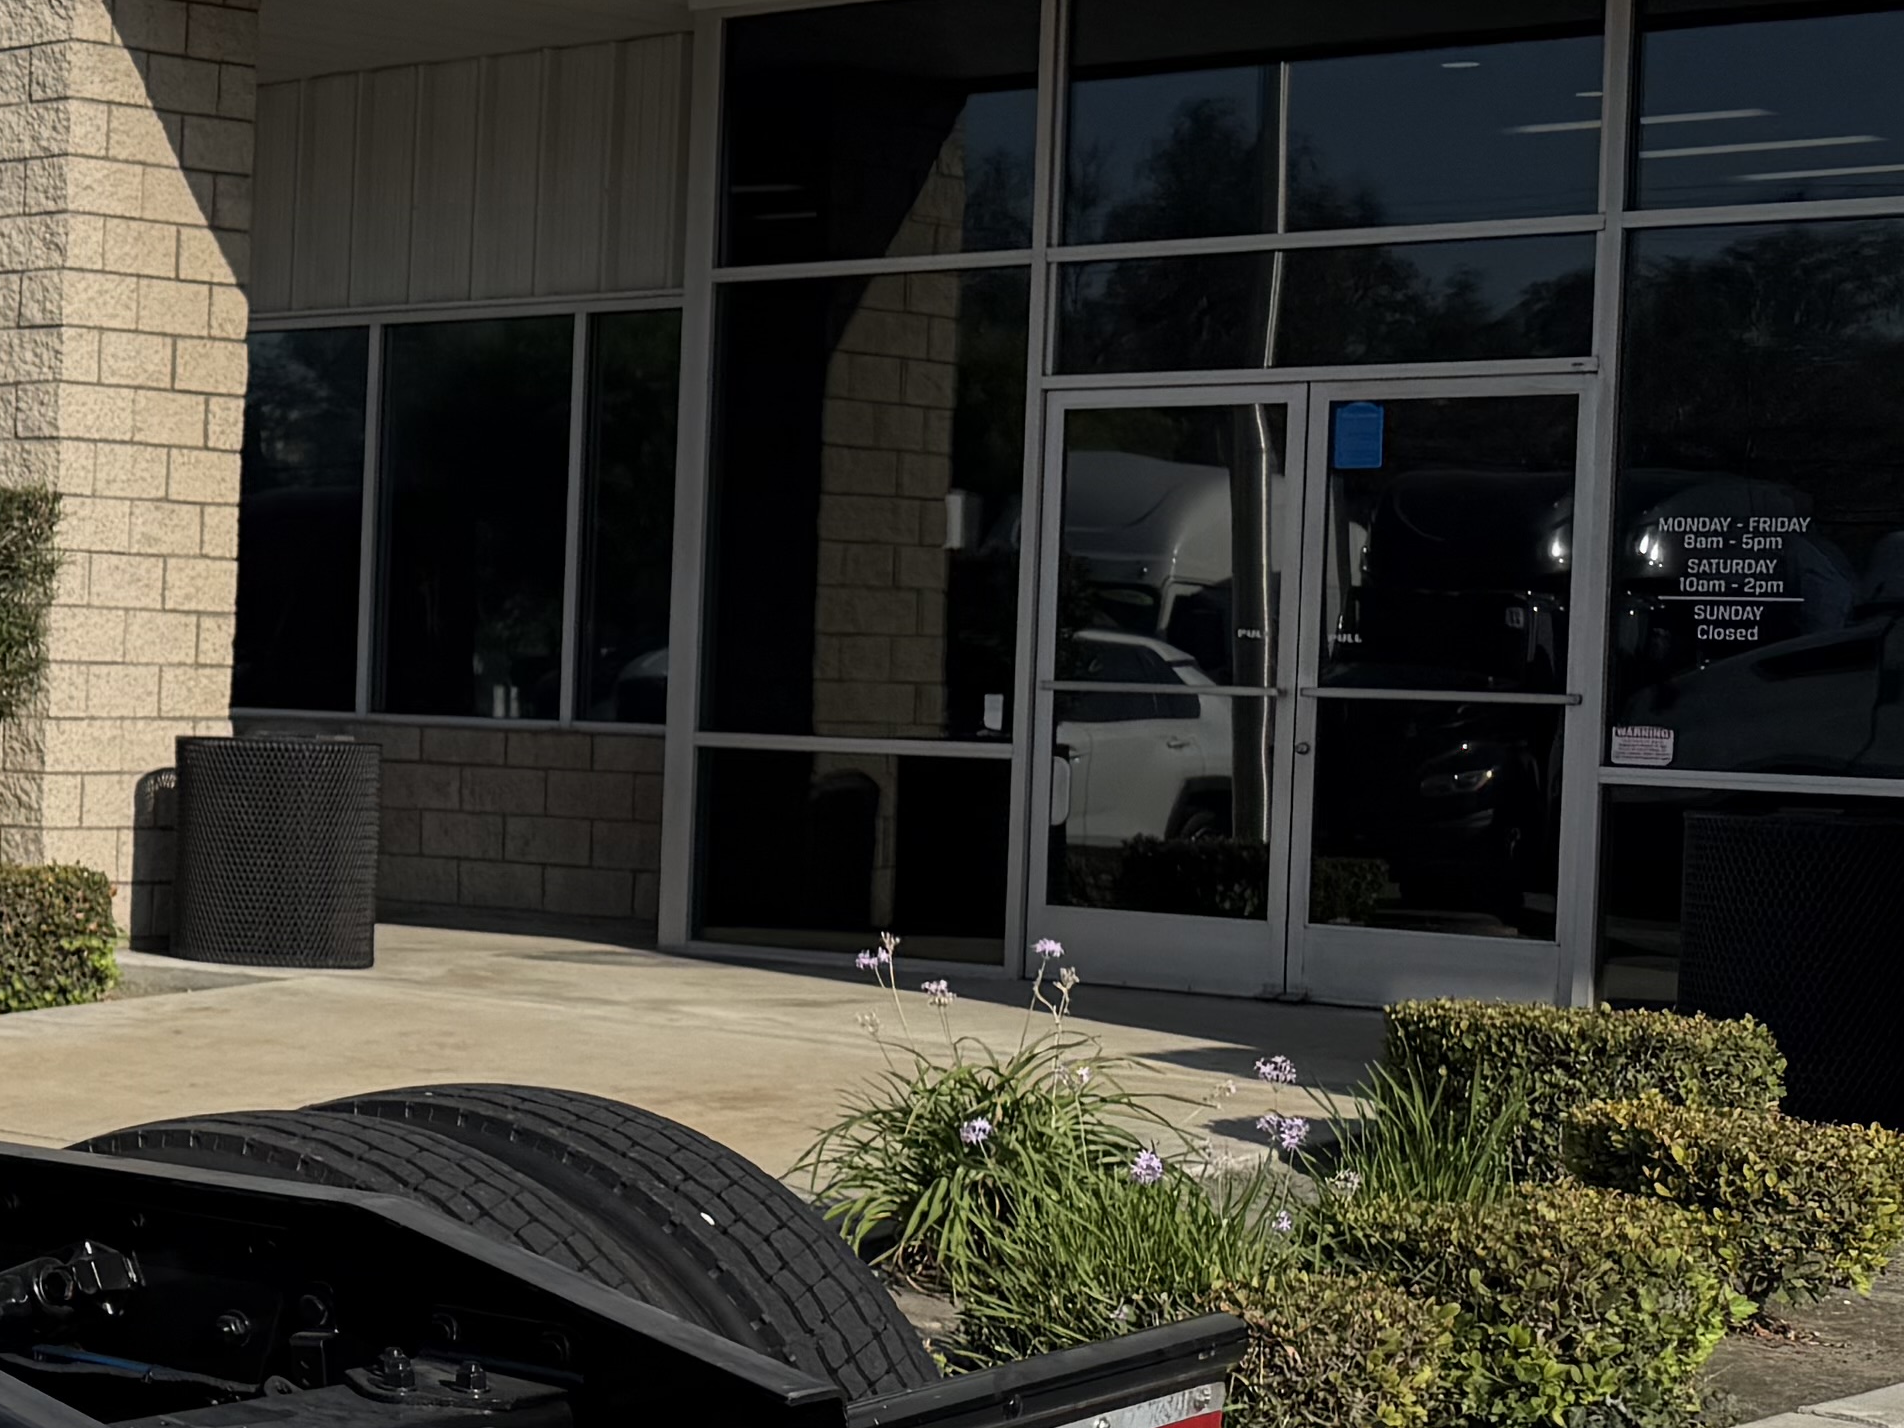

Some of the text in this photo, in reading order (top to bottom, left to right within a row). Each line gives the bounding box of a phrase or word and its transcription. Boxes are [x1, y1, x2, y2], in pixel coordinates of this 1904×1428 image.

[1659, 517, 1732, 532] MONDAY
[1749, 517, 1811, 532] FRIDAY
[1684, 535, 1723, 549] 8am
[1742, 535, 1783, 552] 5pm
[1688, 559, 1777, 574] SATURDAY
[1679, 577, 1726, 592] 10am
[1744, 578, 1784, 595] 2pm
[1694, 605, 1764, 620] SUNDAY
[1237, 629, 1267, 639] PUL
[1697, 625, 1758, 640] Closed
